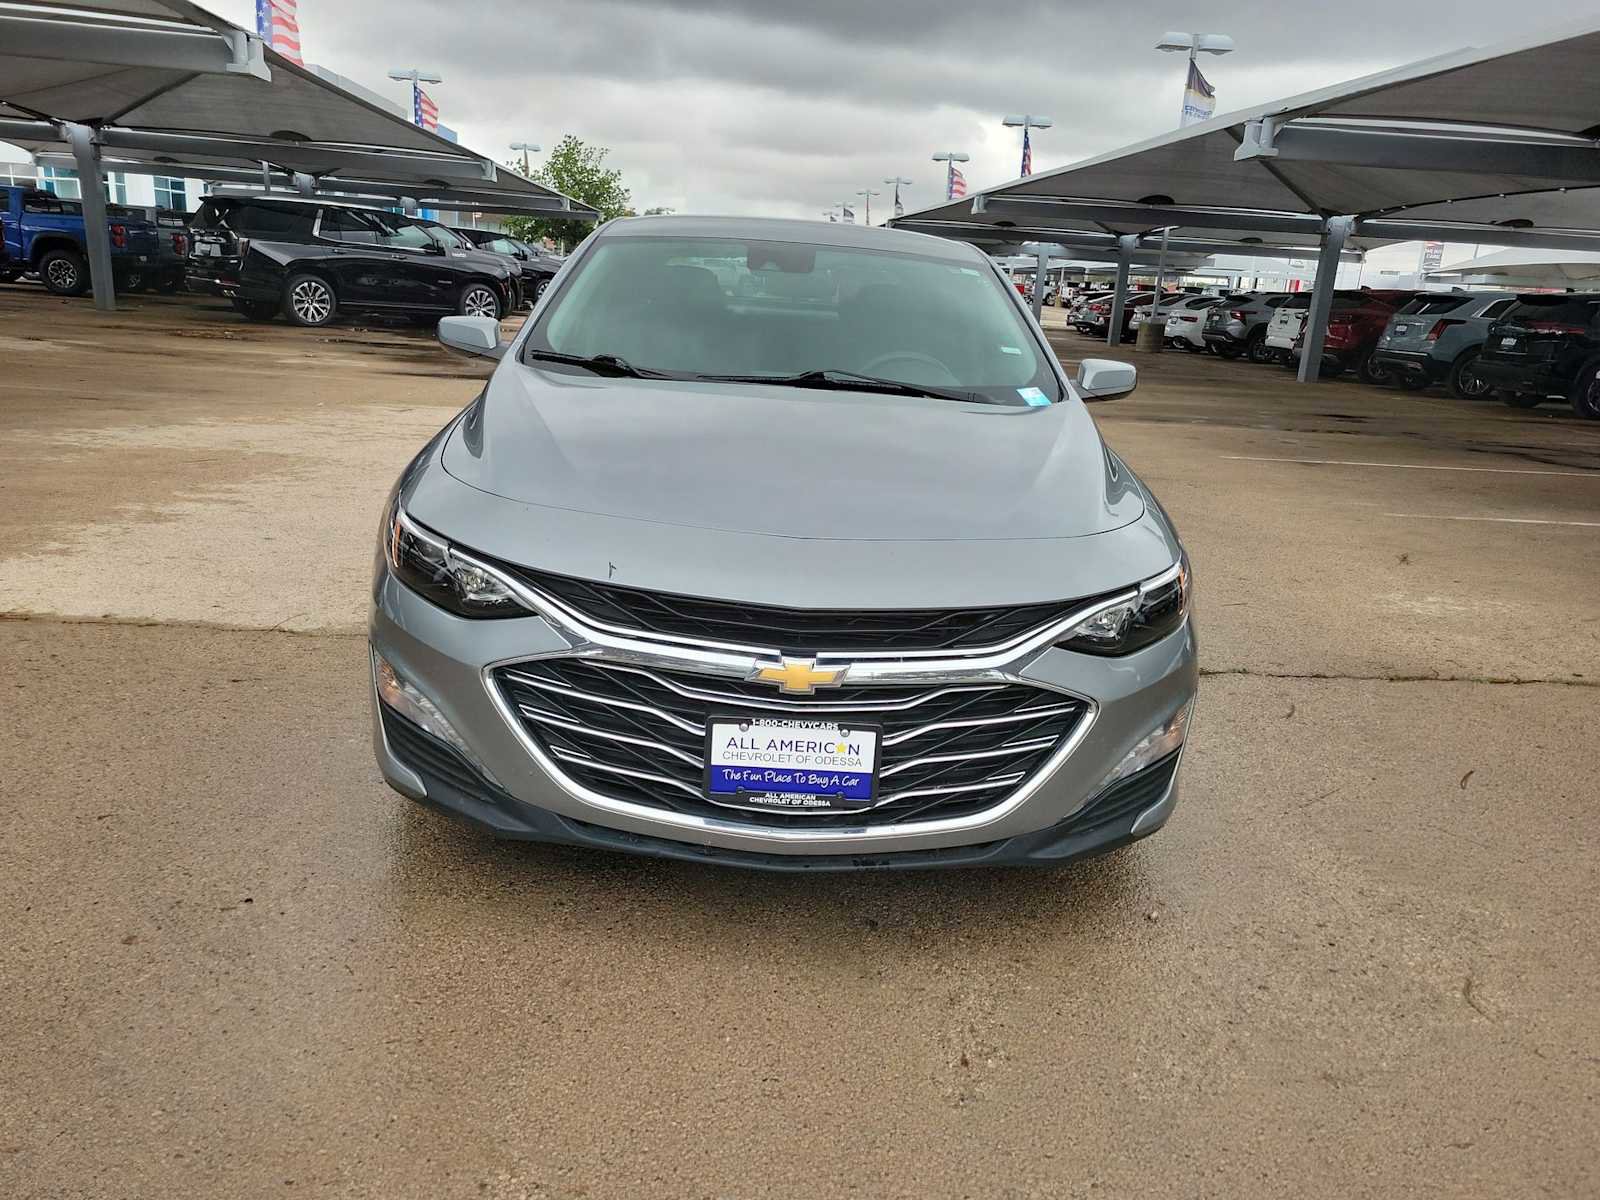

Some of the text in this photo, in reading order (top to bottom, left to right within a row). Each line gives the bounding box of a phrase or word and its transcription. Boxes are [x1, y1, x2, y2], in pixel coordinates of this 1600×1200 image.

[752, 718, 839, 731] 1-800-CHEVYCARS
[726, 737, 760, 750] ALL
[722, 751, 862, 767] CHEVROLET OF ODESSA
[722, 769, 859, 788] The Fun Place To Buy A Car
[749, 797, 790, 805] CHEVROLET
